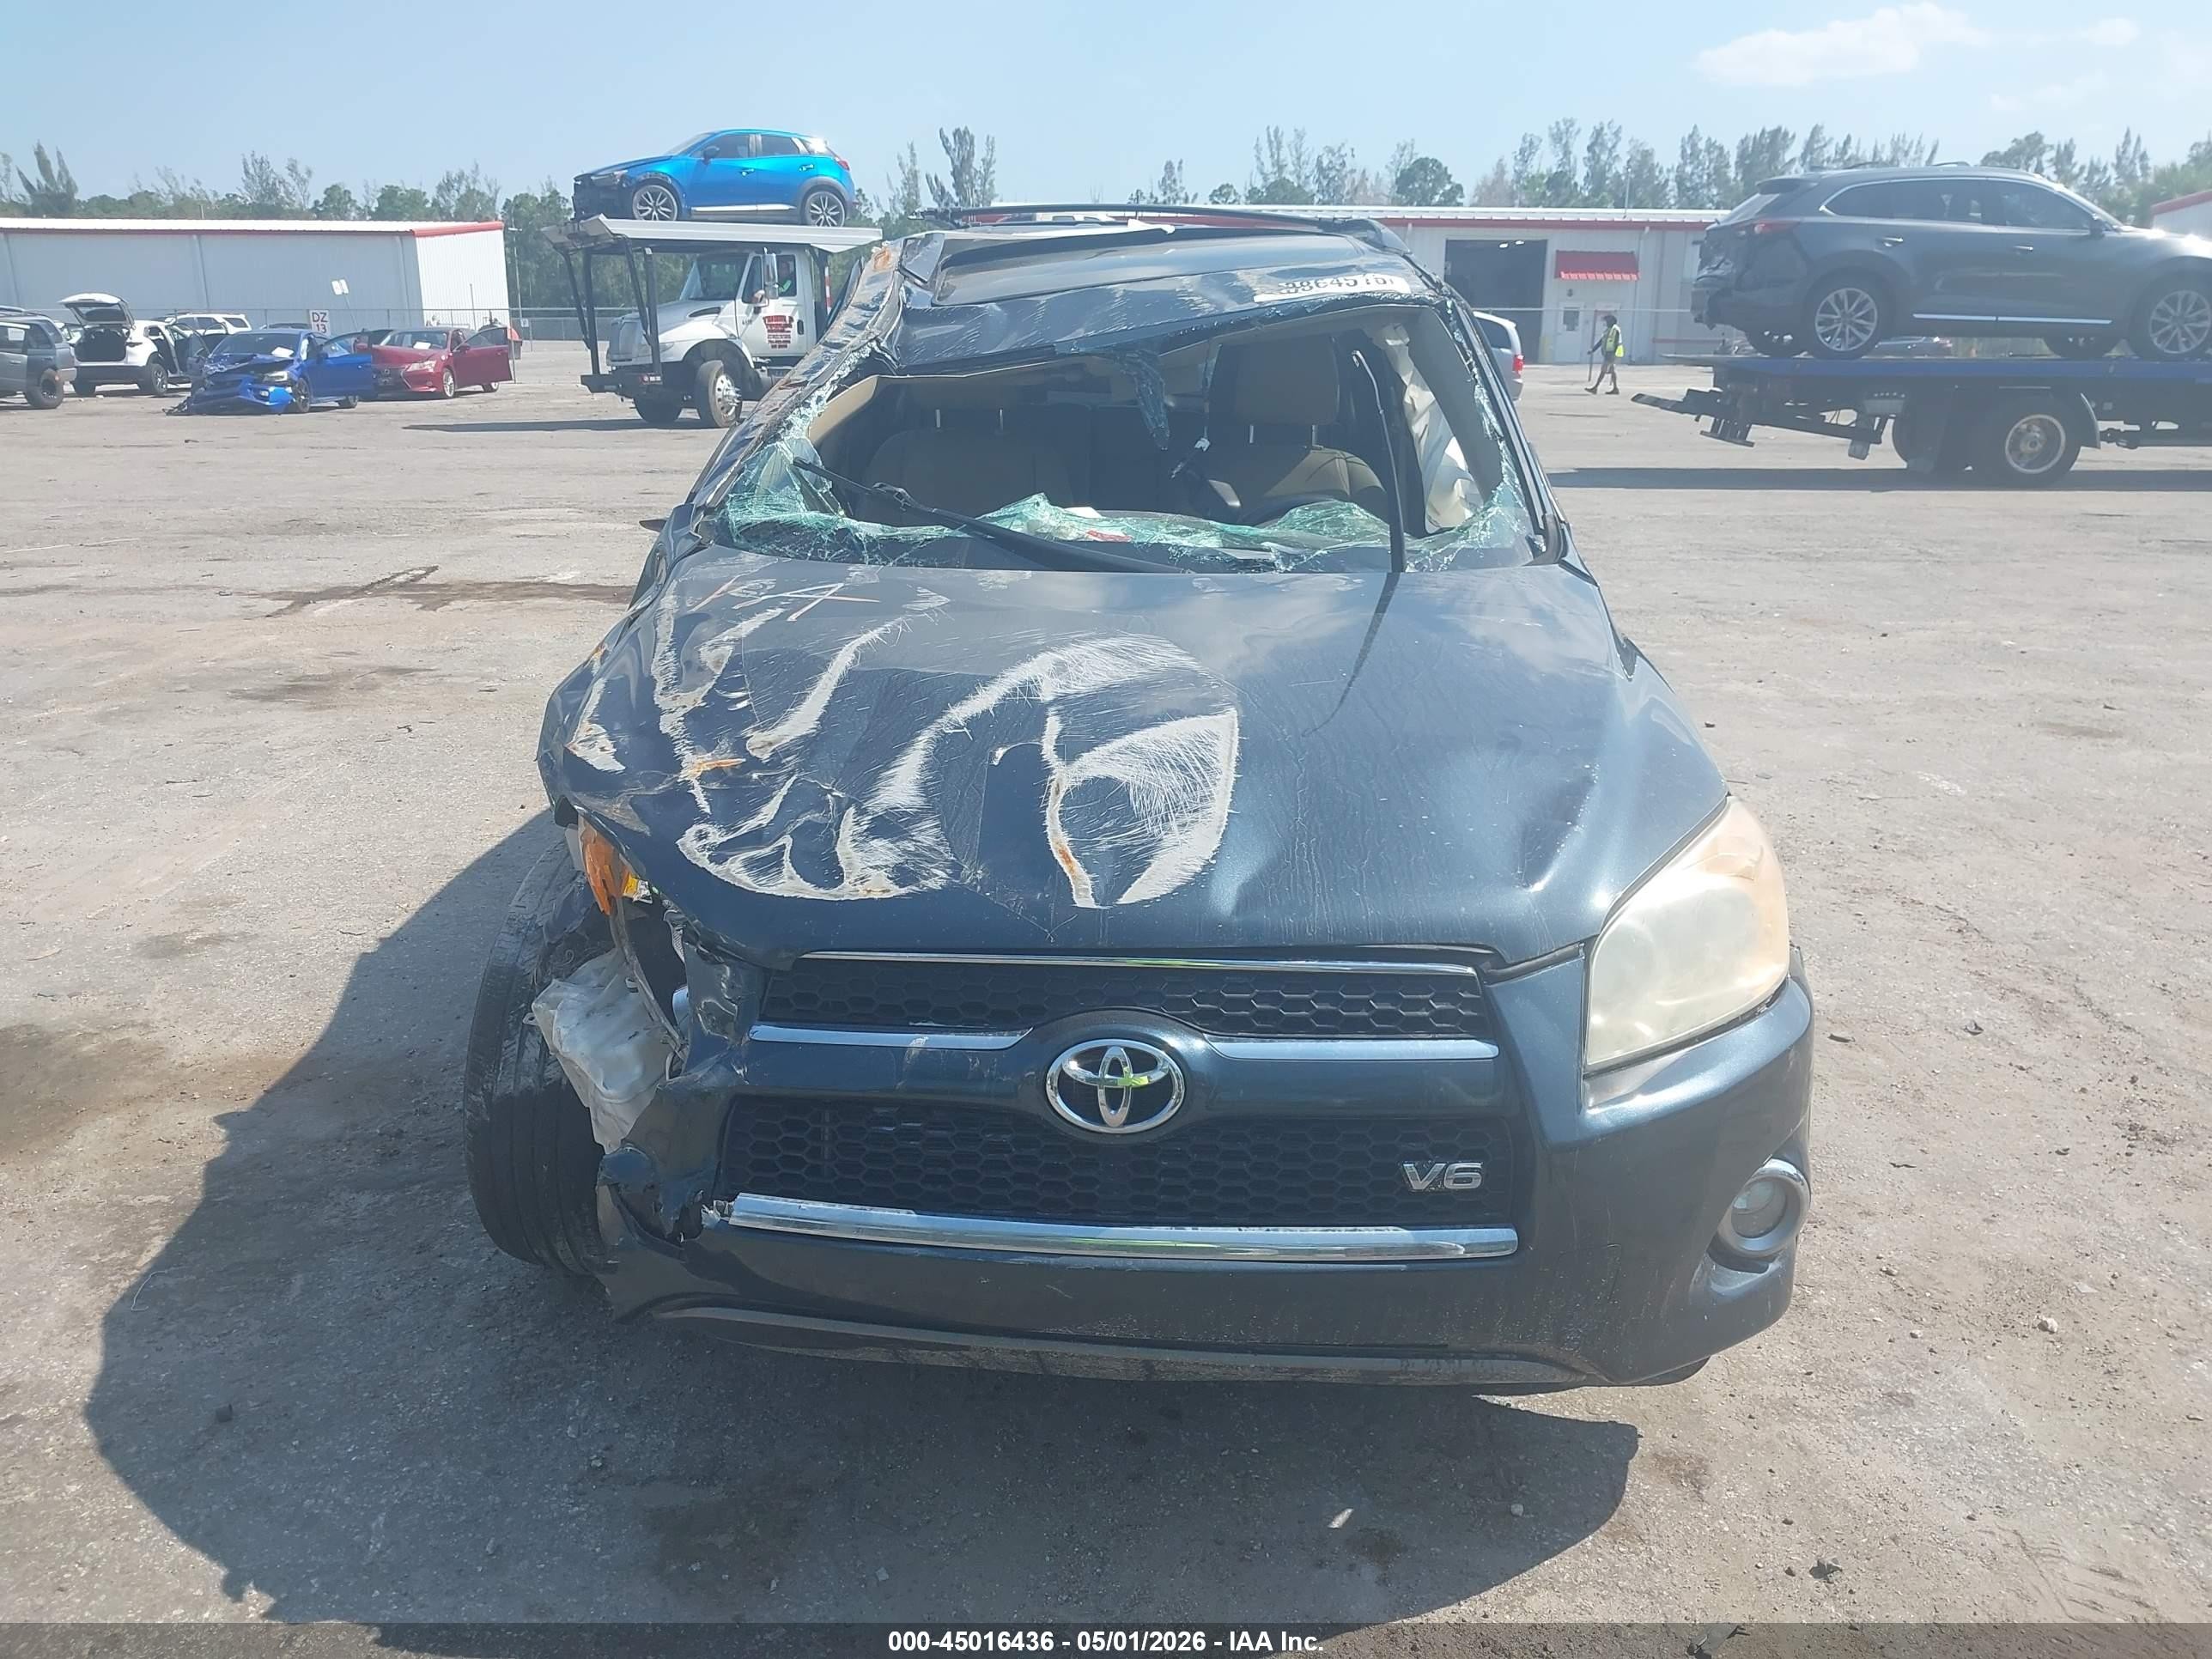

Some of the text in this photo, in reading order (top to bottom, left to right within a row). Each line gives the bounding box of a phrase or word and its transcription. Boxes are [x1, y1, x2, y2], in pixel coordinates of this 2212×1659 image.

[312, 312, 328, 323] DZ
[316, 324, 327, 334] 13
[1403, 1163, 1482, 1190] V6
